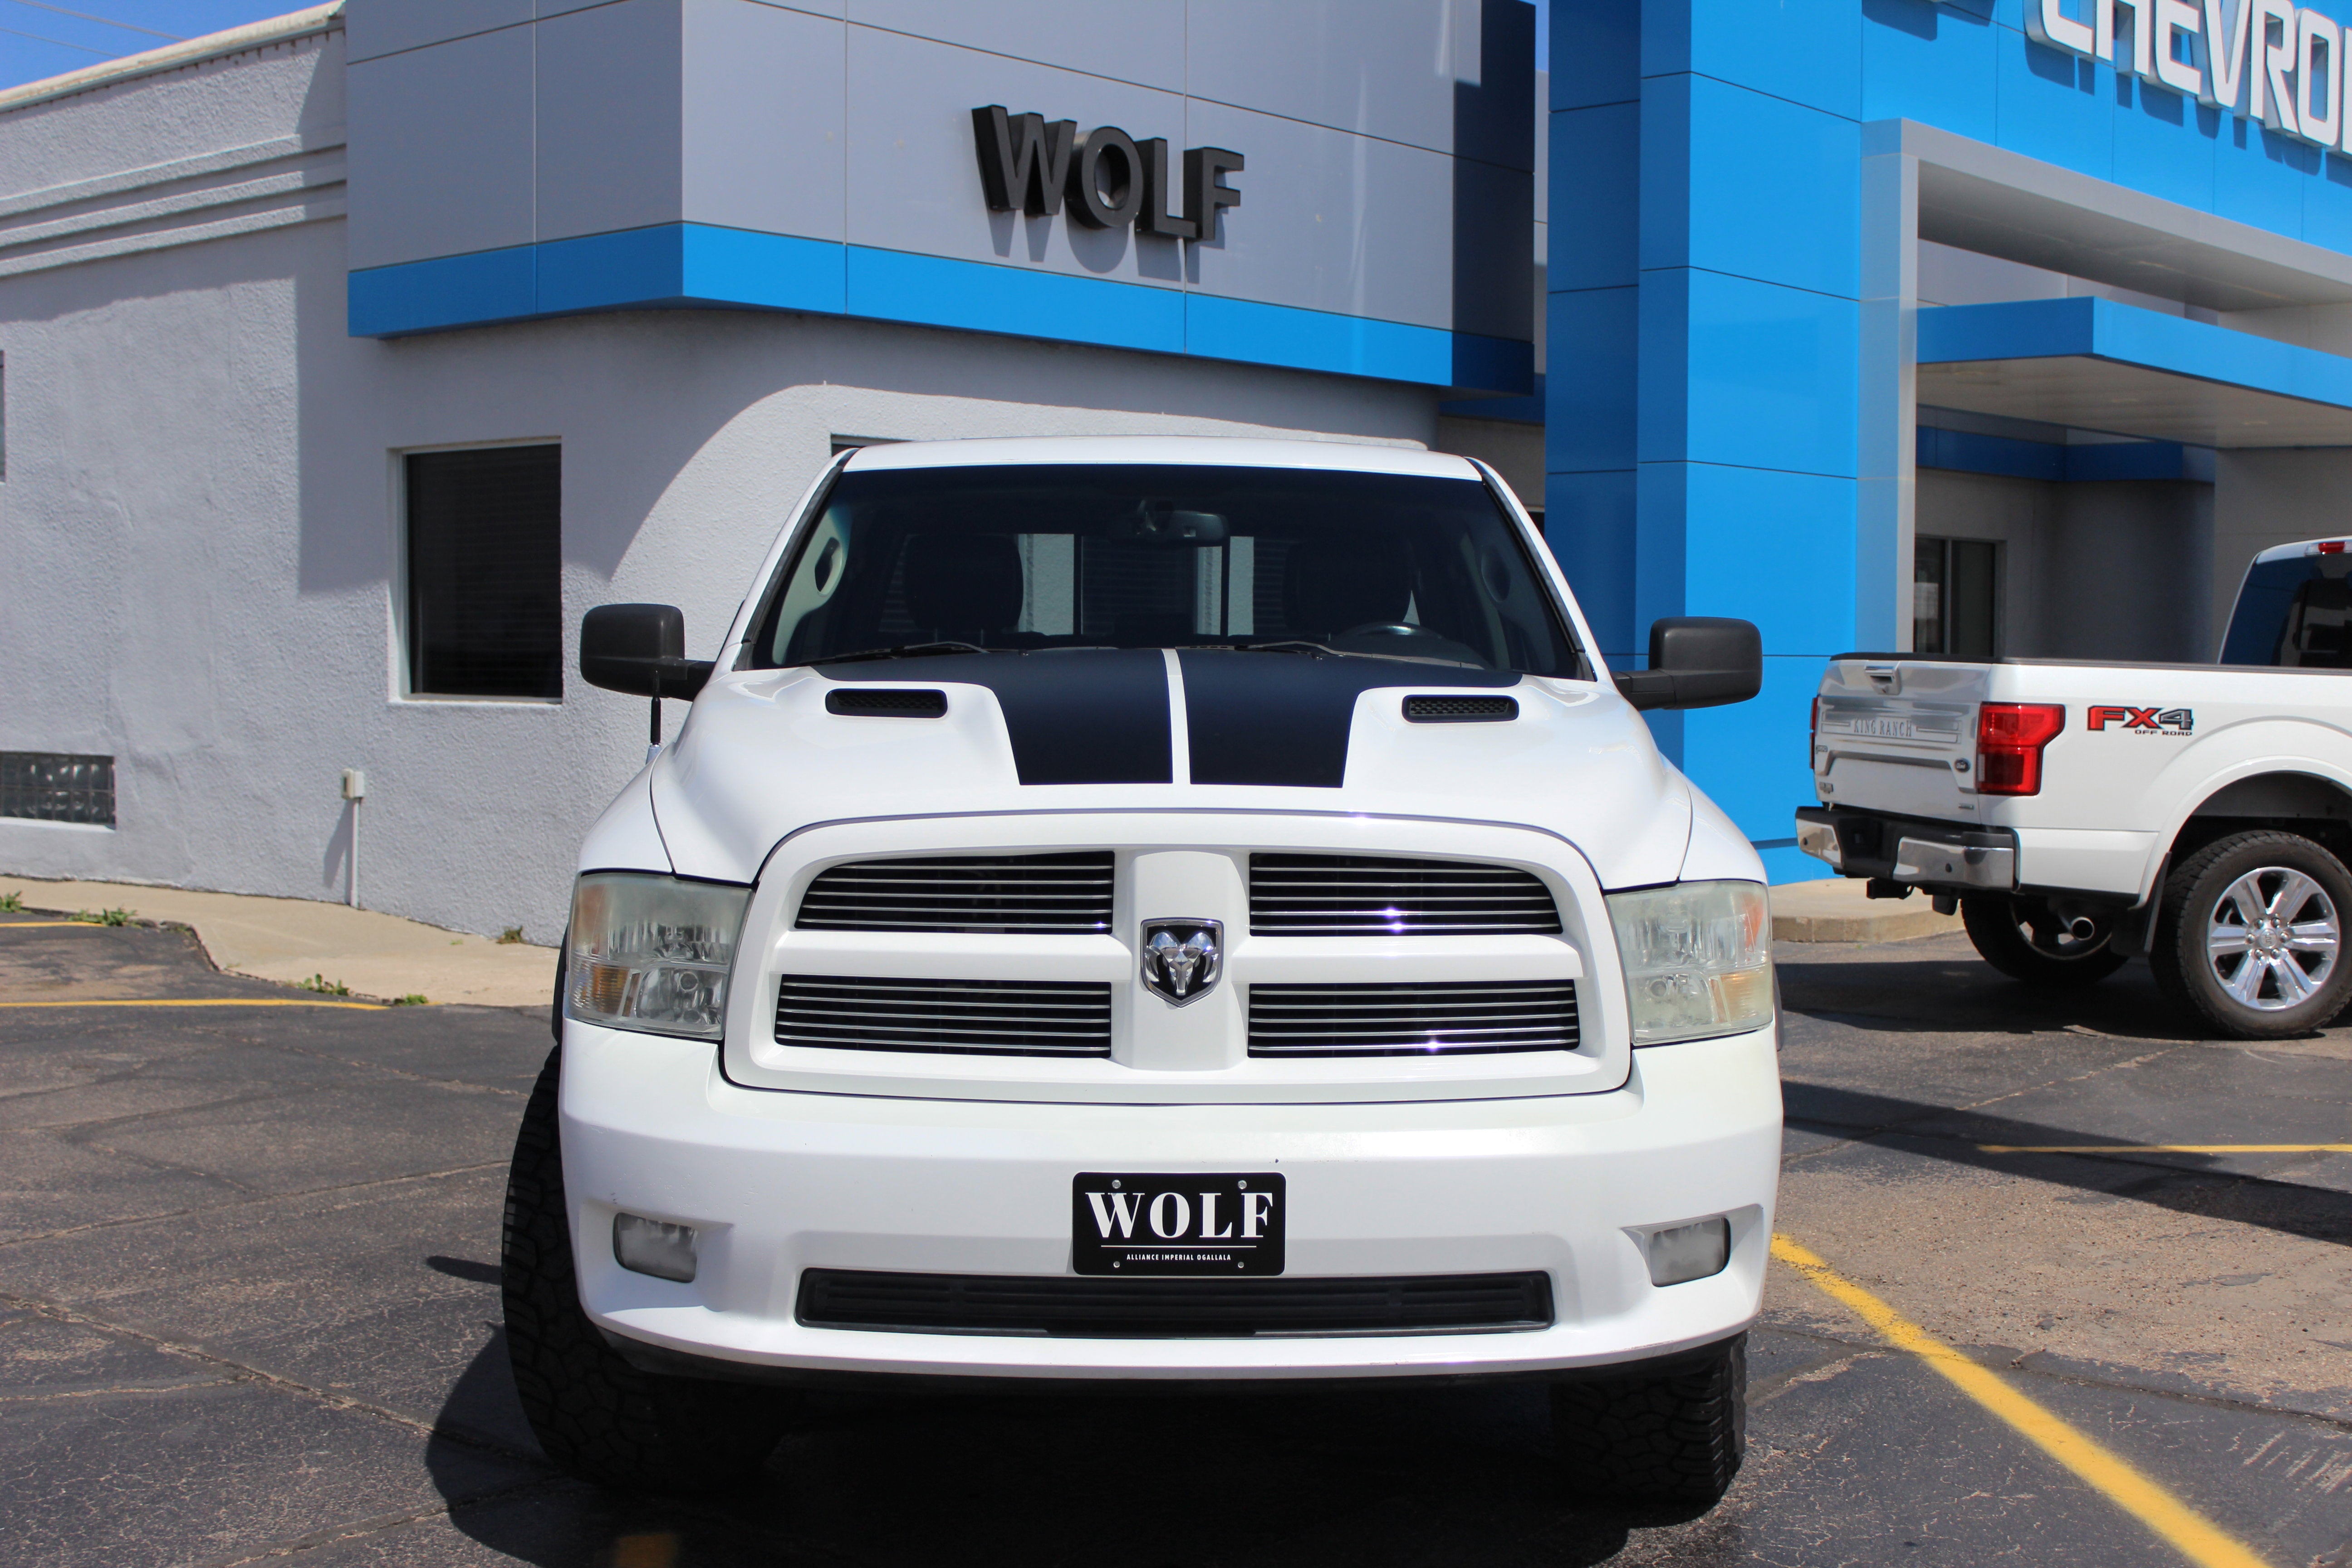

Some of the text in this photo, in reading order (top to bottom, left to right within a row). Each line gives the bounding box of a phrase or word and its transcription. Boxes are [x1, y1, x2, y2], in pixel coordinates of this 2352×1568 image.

[2023, 0, 2352, 158] HEVRO
[972, 104, 1244, 240] WOLF
[1854, 719, 1912, 737] KING RANCH
[2087, 706, 2193, 730] FX4
[1085, 1192, 1273, 1238] WOLF
